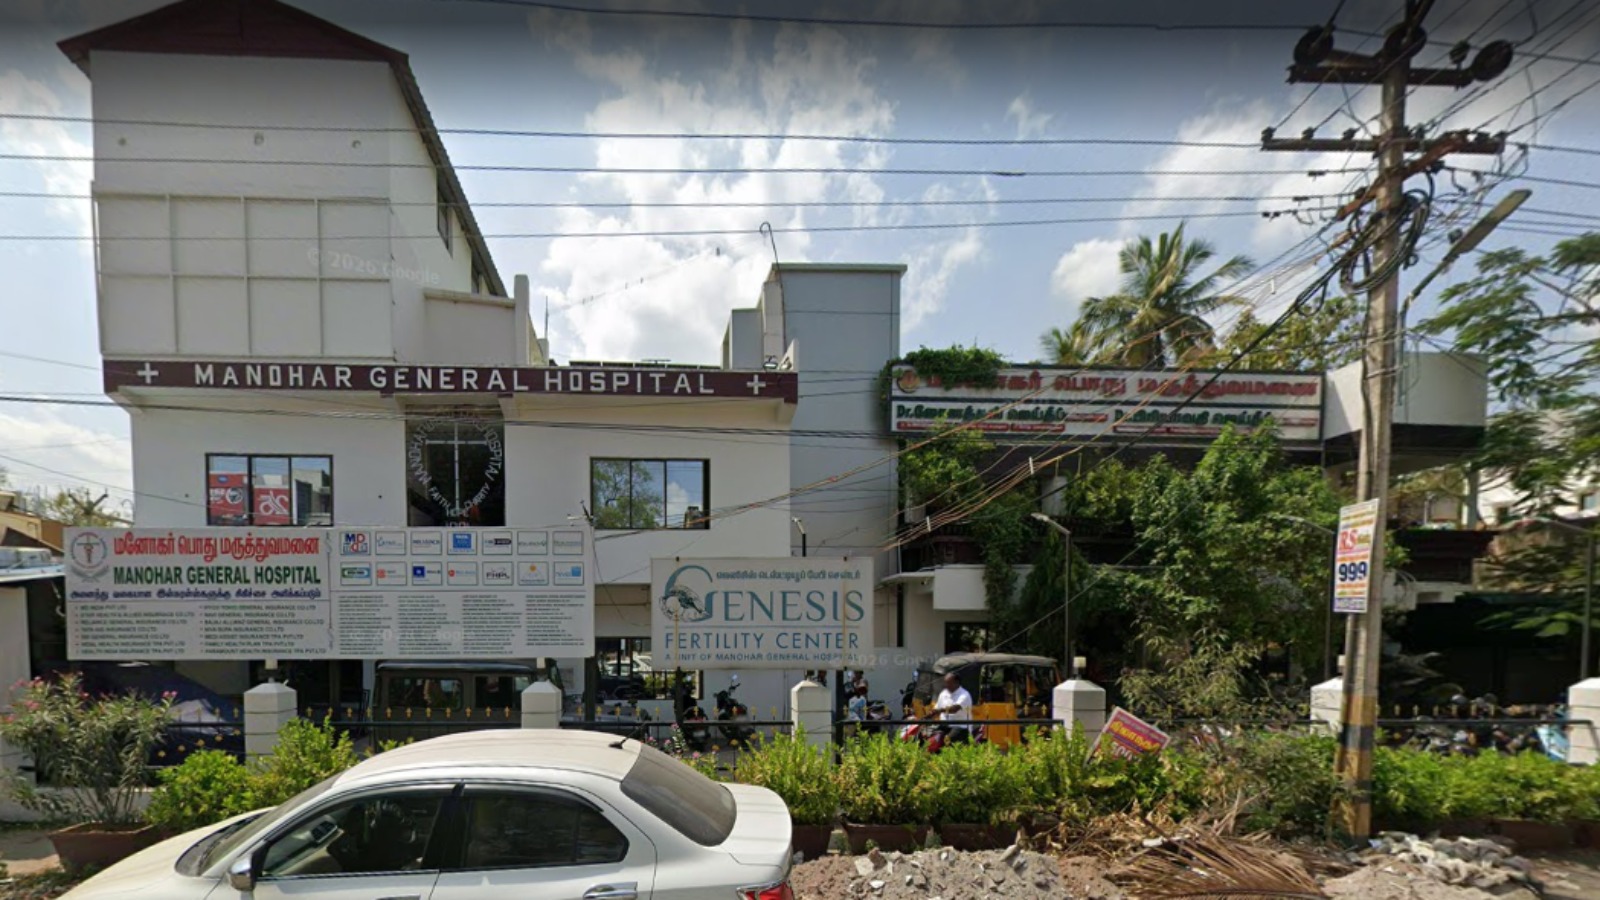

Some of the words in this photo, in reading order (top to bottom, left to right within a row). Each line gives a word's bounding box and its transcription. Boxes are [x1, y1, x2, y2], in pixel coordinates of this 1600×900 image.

[194, 363, 353, 388] MANOHAR
[369, 367, 529, 392] GENERAL
[544, 370, 715, 394] HOSPITAL
[114, 531, 175, 555] மனோகர்
[178, 535, 218, 563] பொது
[220, 532, 320, 563] மருத்துவமனை
[113, 566, 183, 585] MANOHAR
[187, 566, 251, 585] GENERAL
[254, 565, 321, 584] HOSPITAL
[1339, 561, 1368, 582] 999
[663, 565, 865, 623] GENESIS
[665, 632, 764, 649] FERTILITY
[775, 632, 859, 649] CENTER
[665, 653, 671, 661] A
[699, 653, 711, 661] OF
[715, 653, 764, 661] MANOHAR
[766, 653, 810, 662] GENERAL
